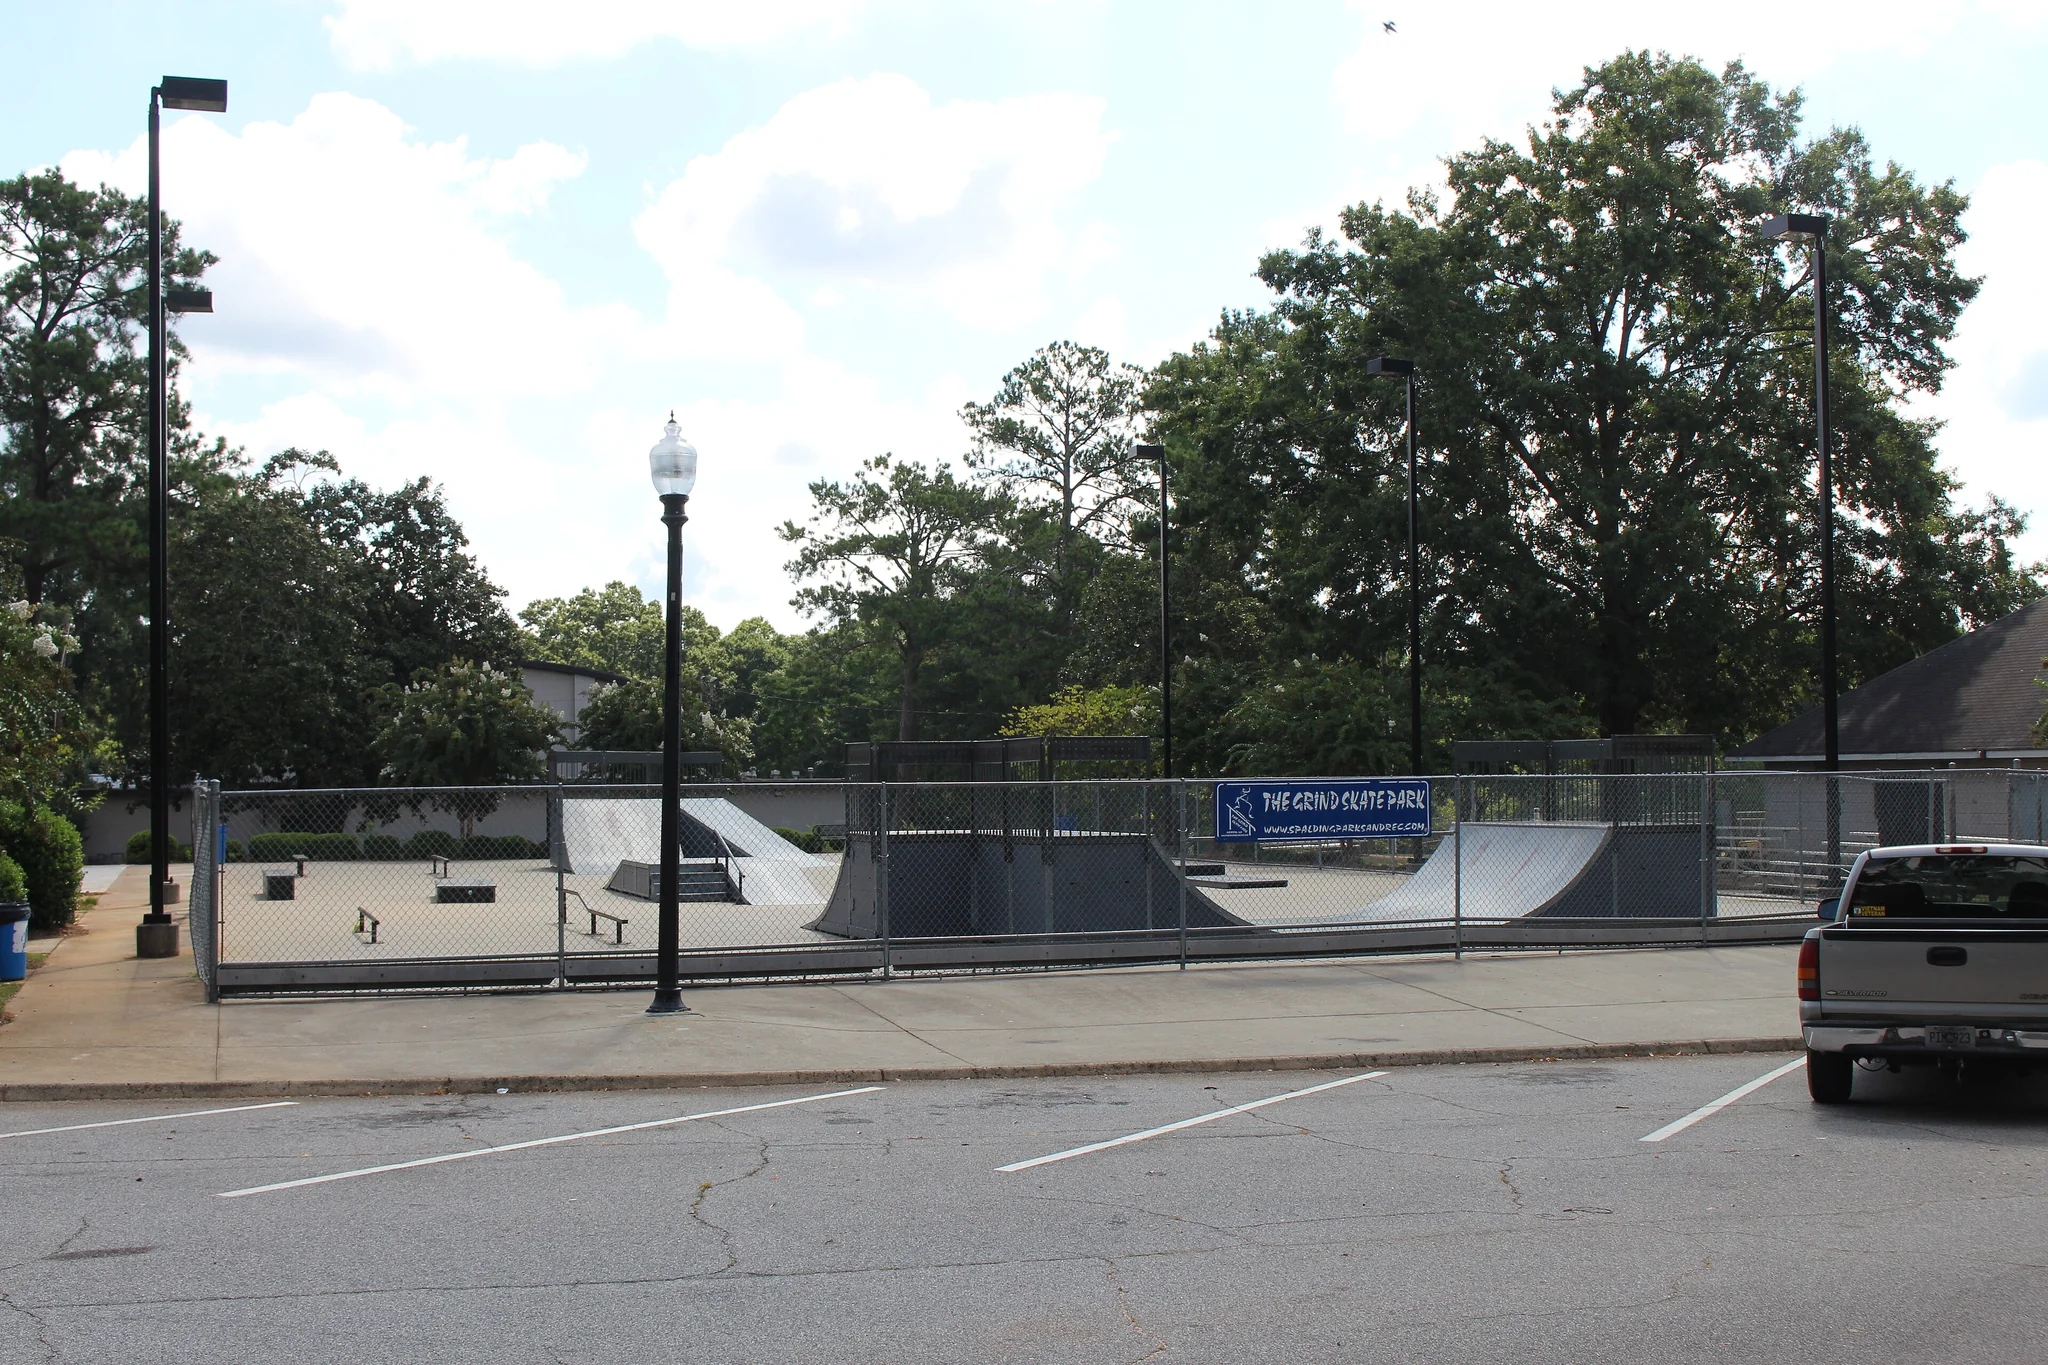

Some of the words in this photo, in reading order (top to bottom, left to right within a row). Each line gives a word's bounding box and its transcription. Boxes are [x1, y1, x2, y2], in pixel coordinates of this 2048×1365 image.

[1262, 791, 1291, 812] THE
[1292, 791, 1340, 812] GRIND
[1341, 790, 1385, 811] SKATE
[1386, 789, 1426, 811] PARK
